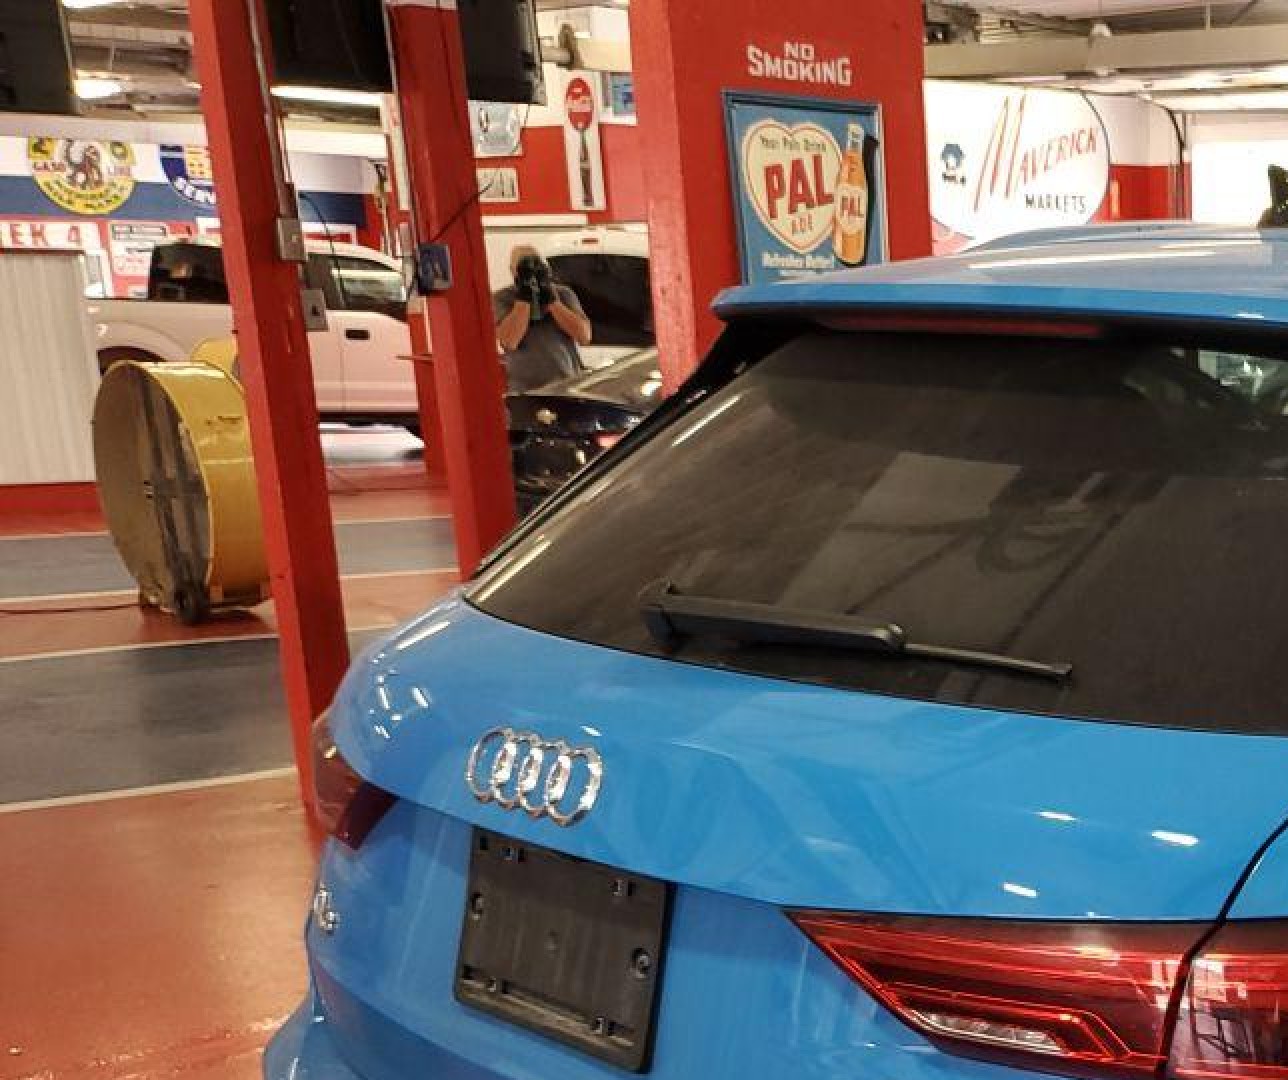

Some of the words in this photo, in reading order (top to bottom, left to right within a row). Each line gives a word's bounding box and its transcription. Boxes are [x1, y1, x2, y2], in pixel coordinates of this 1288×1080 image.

[747, 44, 852, 86] SMOKING
[784, 42, 814, 60] NO
[974, 95, 1098, 212] MAVERICK
[764, 153, 835, 219] PAL
[840, 195, 865, 219] PAL
[1025, 194, 1087, 214] MARKETS
